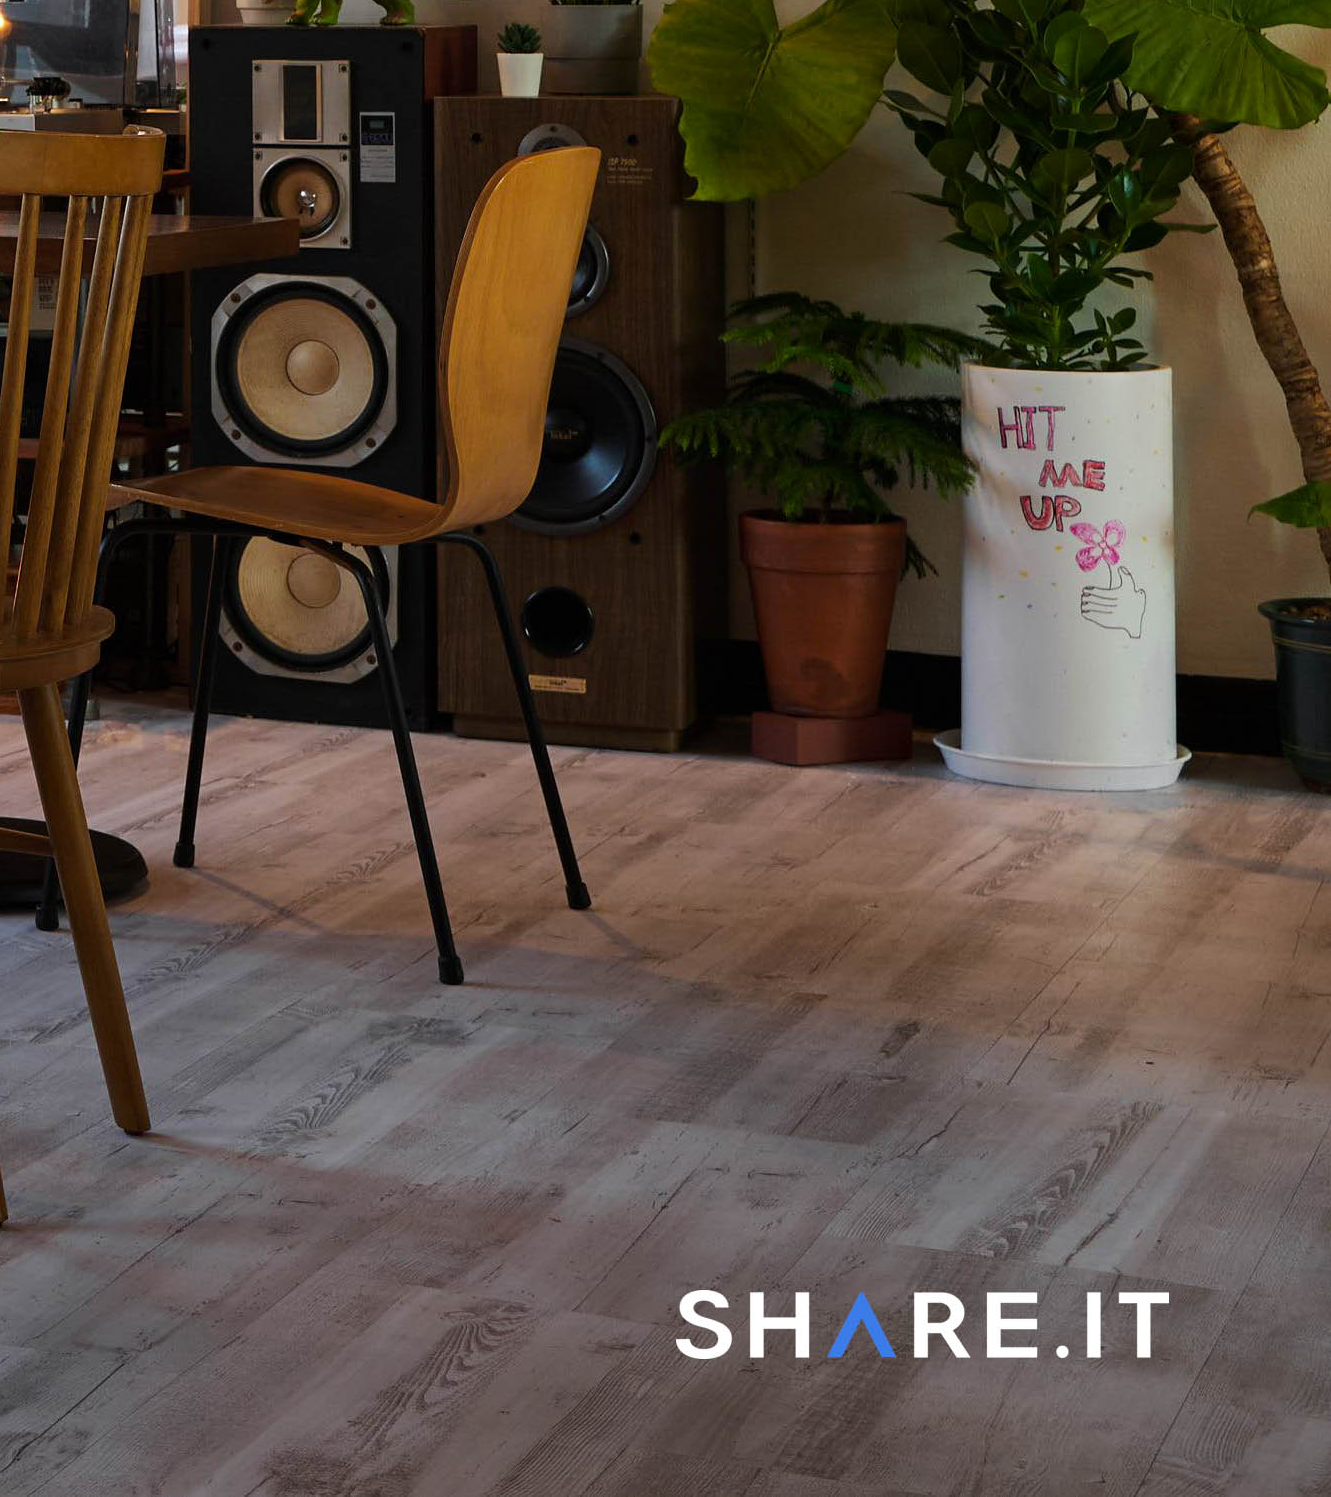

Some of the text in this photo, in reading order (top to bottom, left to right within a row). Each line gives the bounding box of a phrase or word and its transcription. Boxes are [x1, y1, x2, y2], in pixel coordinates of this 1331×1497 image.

[997, 405, 1066, 452] HIT
[1038, 459, 1106, 492] ME
[1019, 494, 1082, 533] UP
